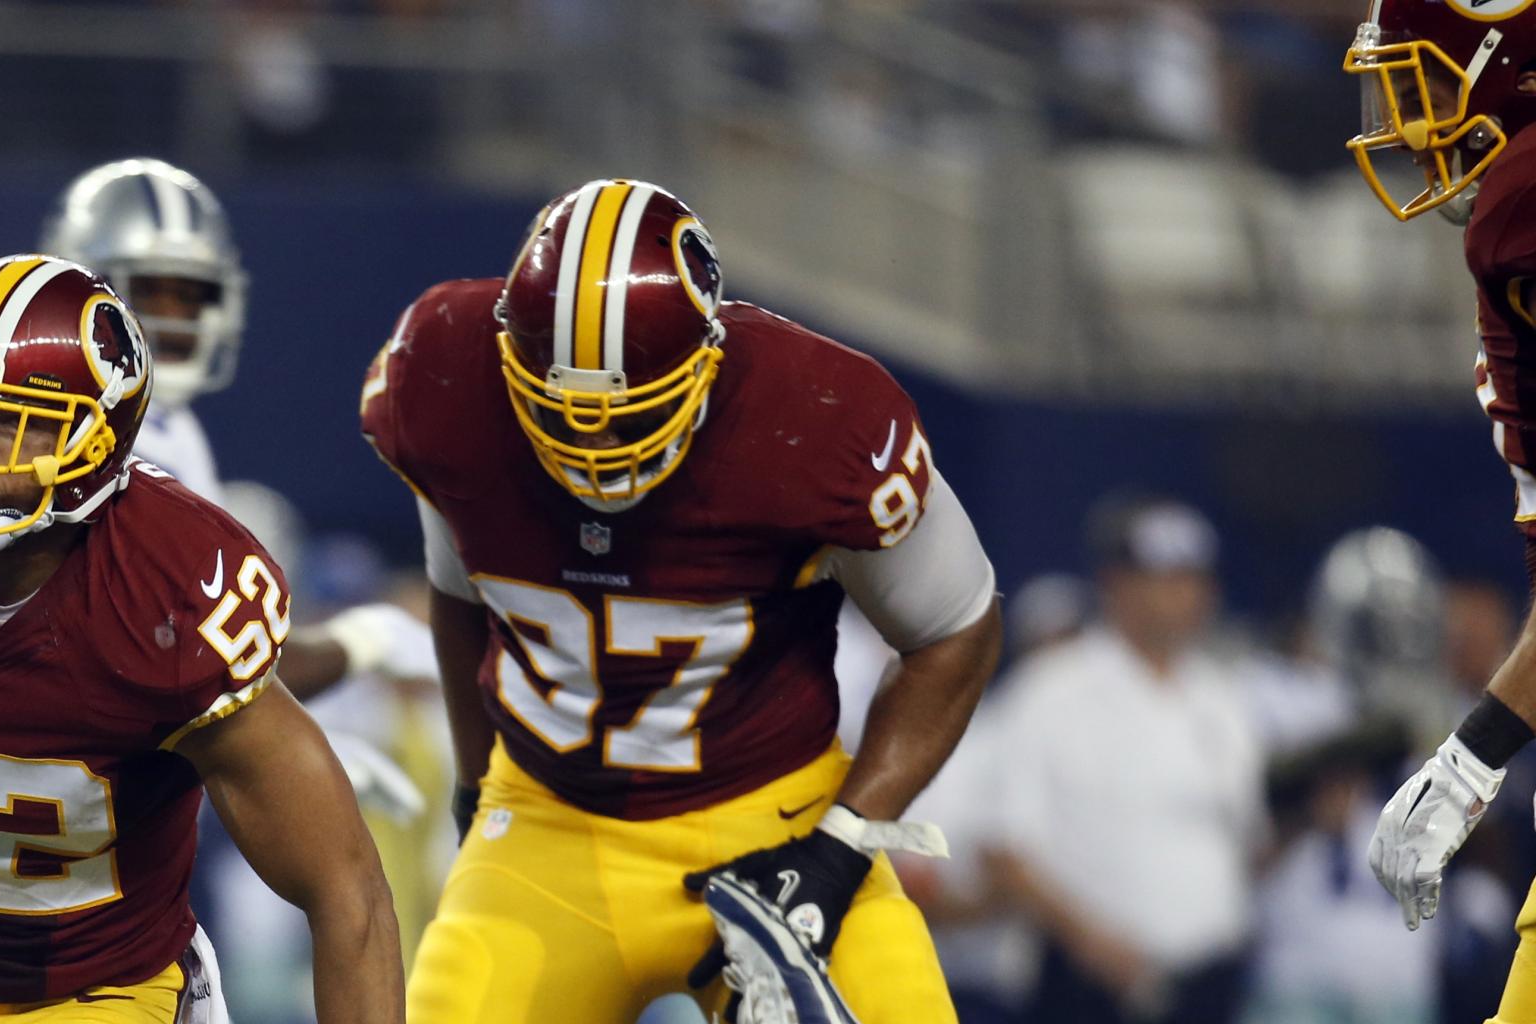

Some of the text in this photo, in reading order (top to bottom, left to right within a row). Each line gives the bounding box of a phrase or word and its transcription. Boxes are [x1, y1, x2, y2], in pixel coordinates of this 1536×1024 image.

[28, 375, 62, 390] REDSKINS
[562, 569, 631, 587] REDSKINS
[197, 554, 292, 680] 52
[468, 571, 755, 774] 97
